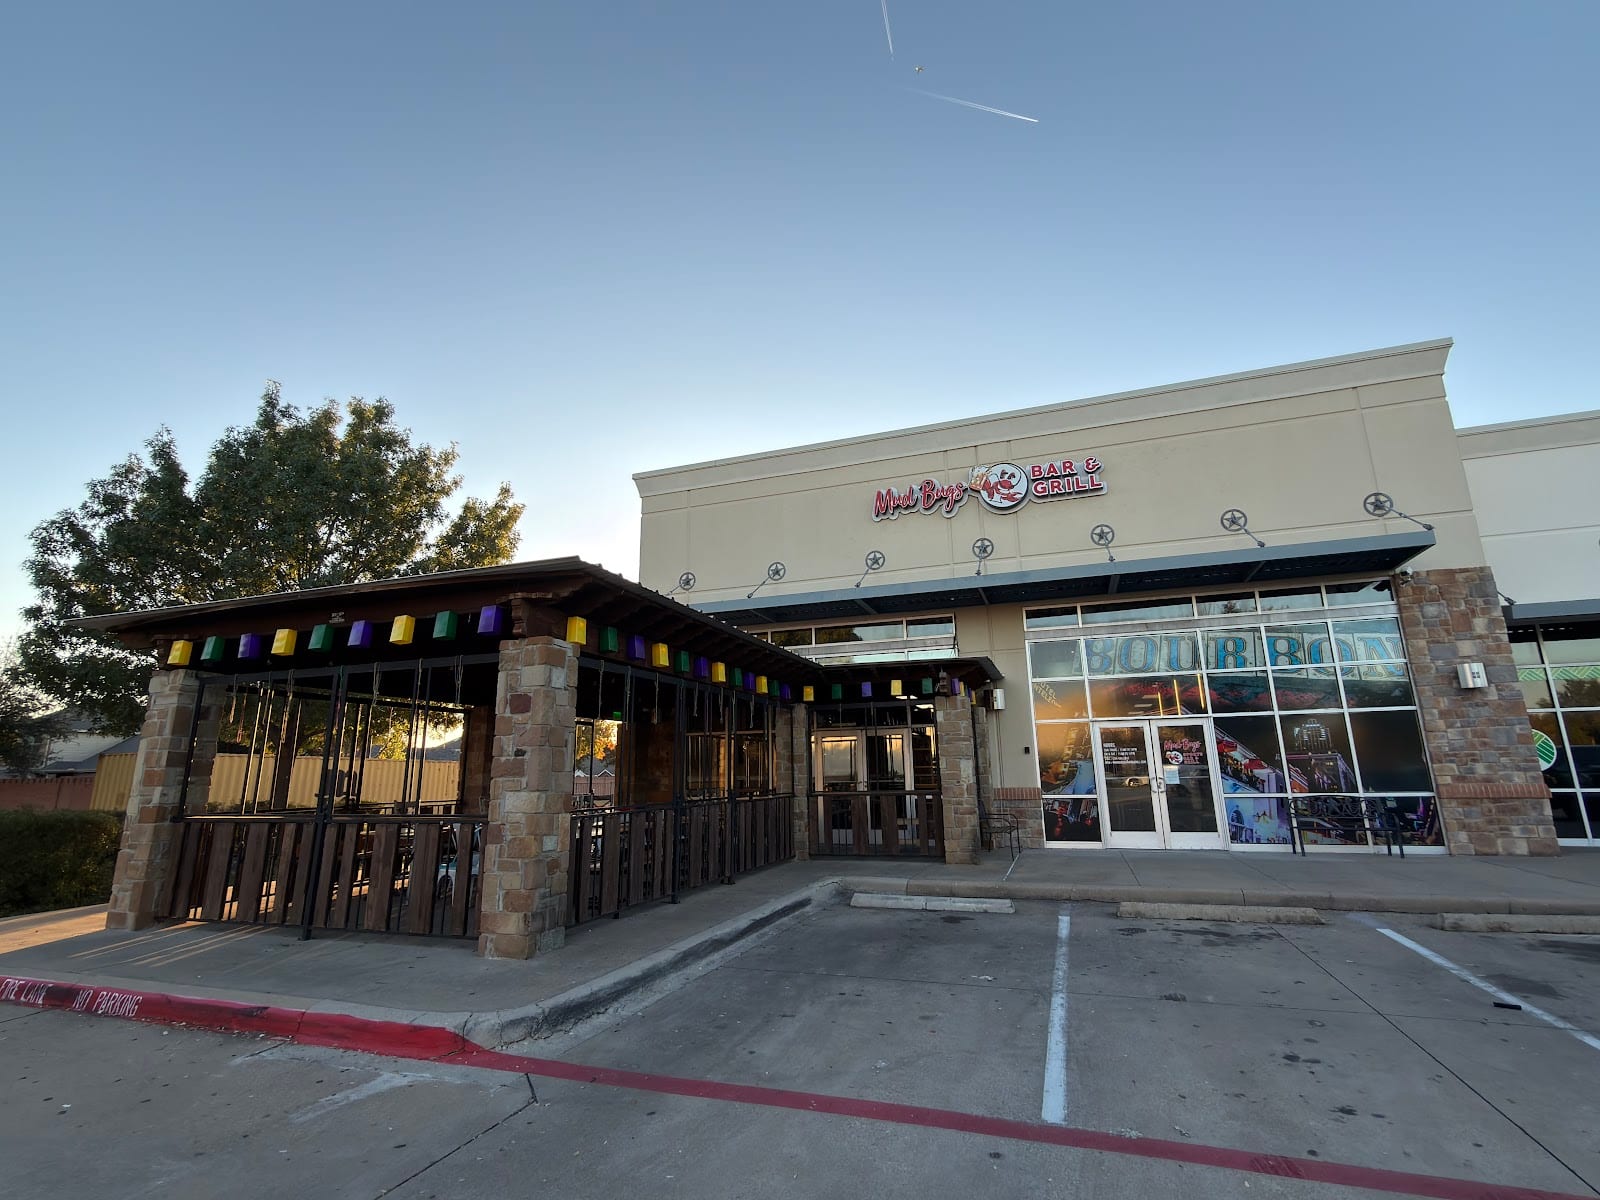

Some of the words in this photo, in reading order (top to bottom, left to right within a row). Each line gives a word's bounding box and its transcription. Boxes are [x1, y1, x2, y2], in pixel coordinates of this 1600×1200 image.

[1030, 459, 1077, 479] BAR
[1083, 456, 1101, 472] &
[1032, 474, 1103, 496] GRILL
[874, 485, 918, 516] Mud
[920, 479, 966, 512] Bugs
[1084, 635, 1406, 677] BOURBON
[0, 979, 26, 1000] FIRE
[20, 981, 54, 1004] LANE
[72, 989, 94, 1010] NO
[92, 991, 143, 1016] PARKING
